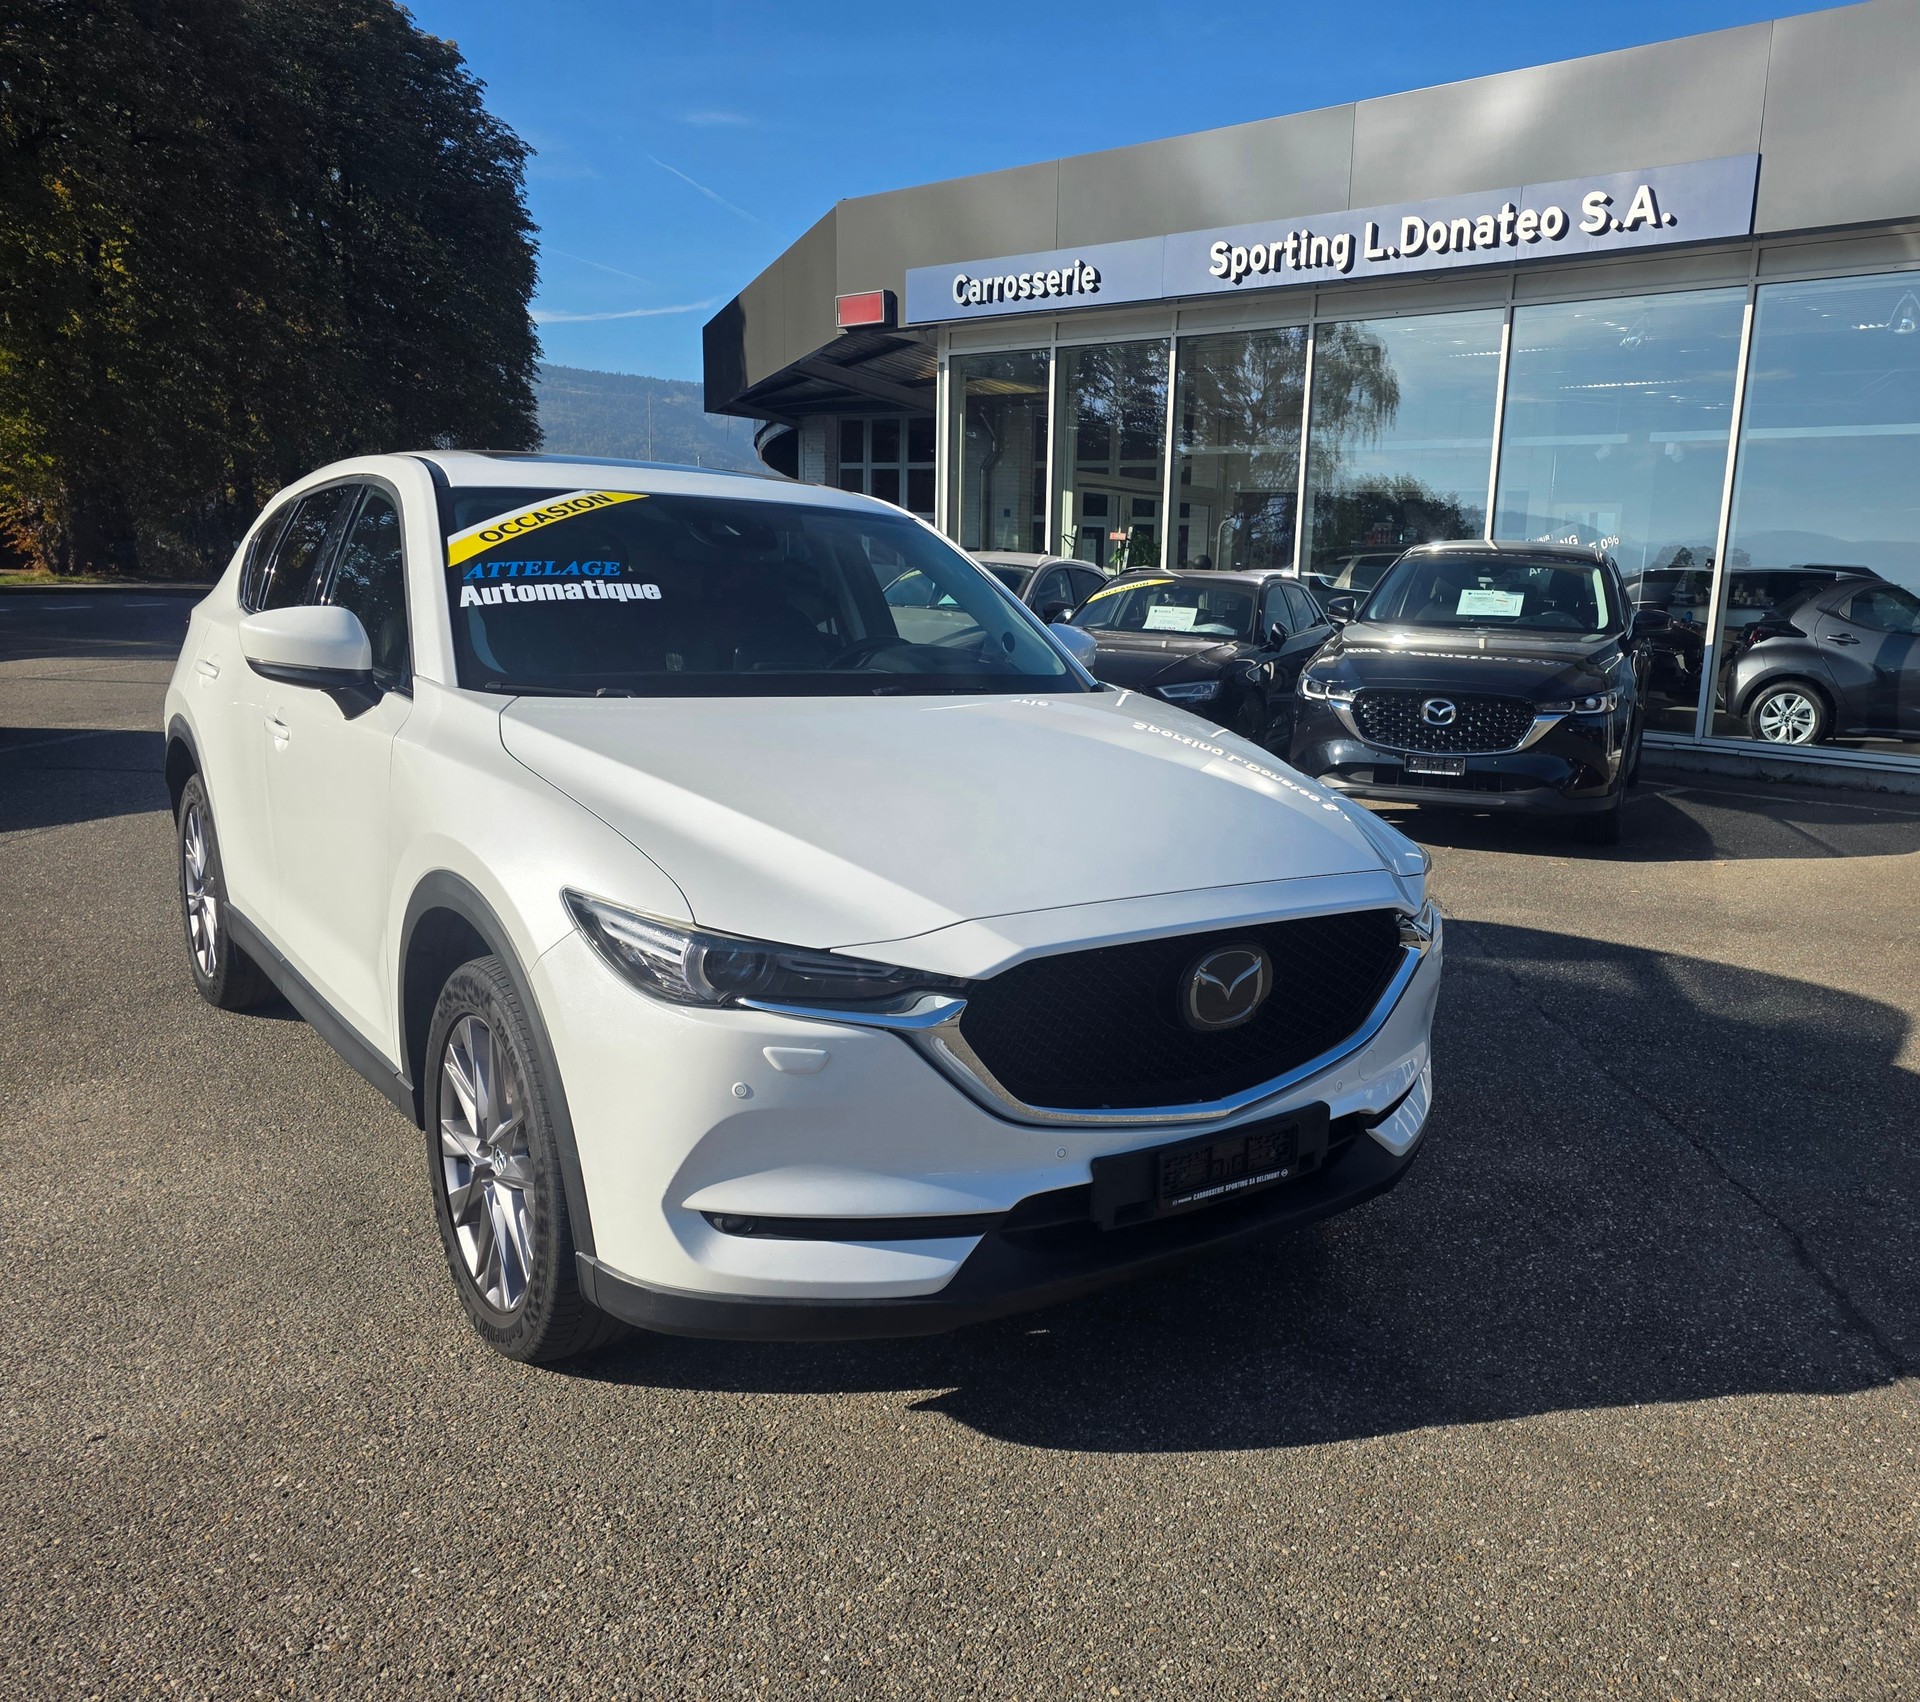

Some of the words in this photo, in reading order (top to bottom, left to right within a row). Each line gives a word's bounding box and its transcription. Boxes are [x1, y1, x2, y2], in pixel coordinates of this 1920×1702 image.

[952, 258, 1098, 305] Carrosserie
[1208, 229, 1352, 282] Sporting
[1363, 201, 1565, 259] L.Donateo
[1578, 184, 1672, 233] S.A.
[478, 493, 614, 543] OCCASION
[462, 560, 622, 581] ATTELAGE
[459, 579, 663, 608] Automatique
[478, 1317, 524, 1349] Continental
